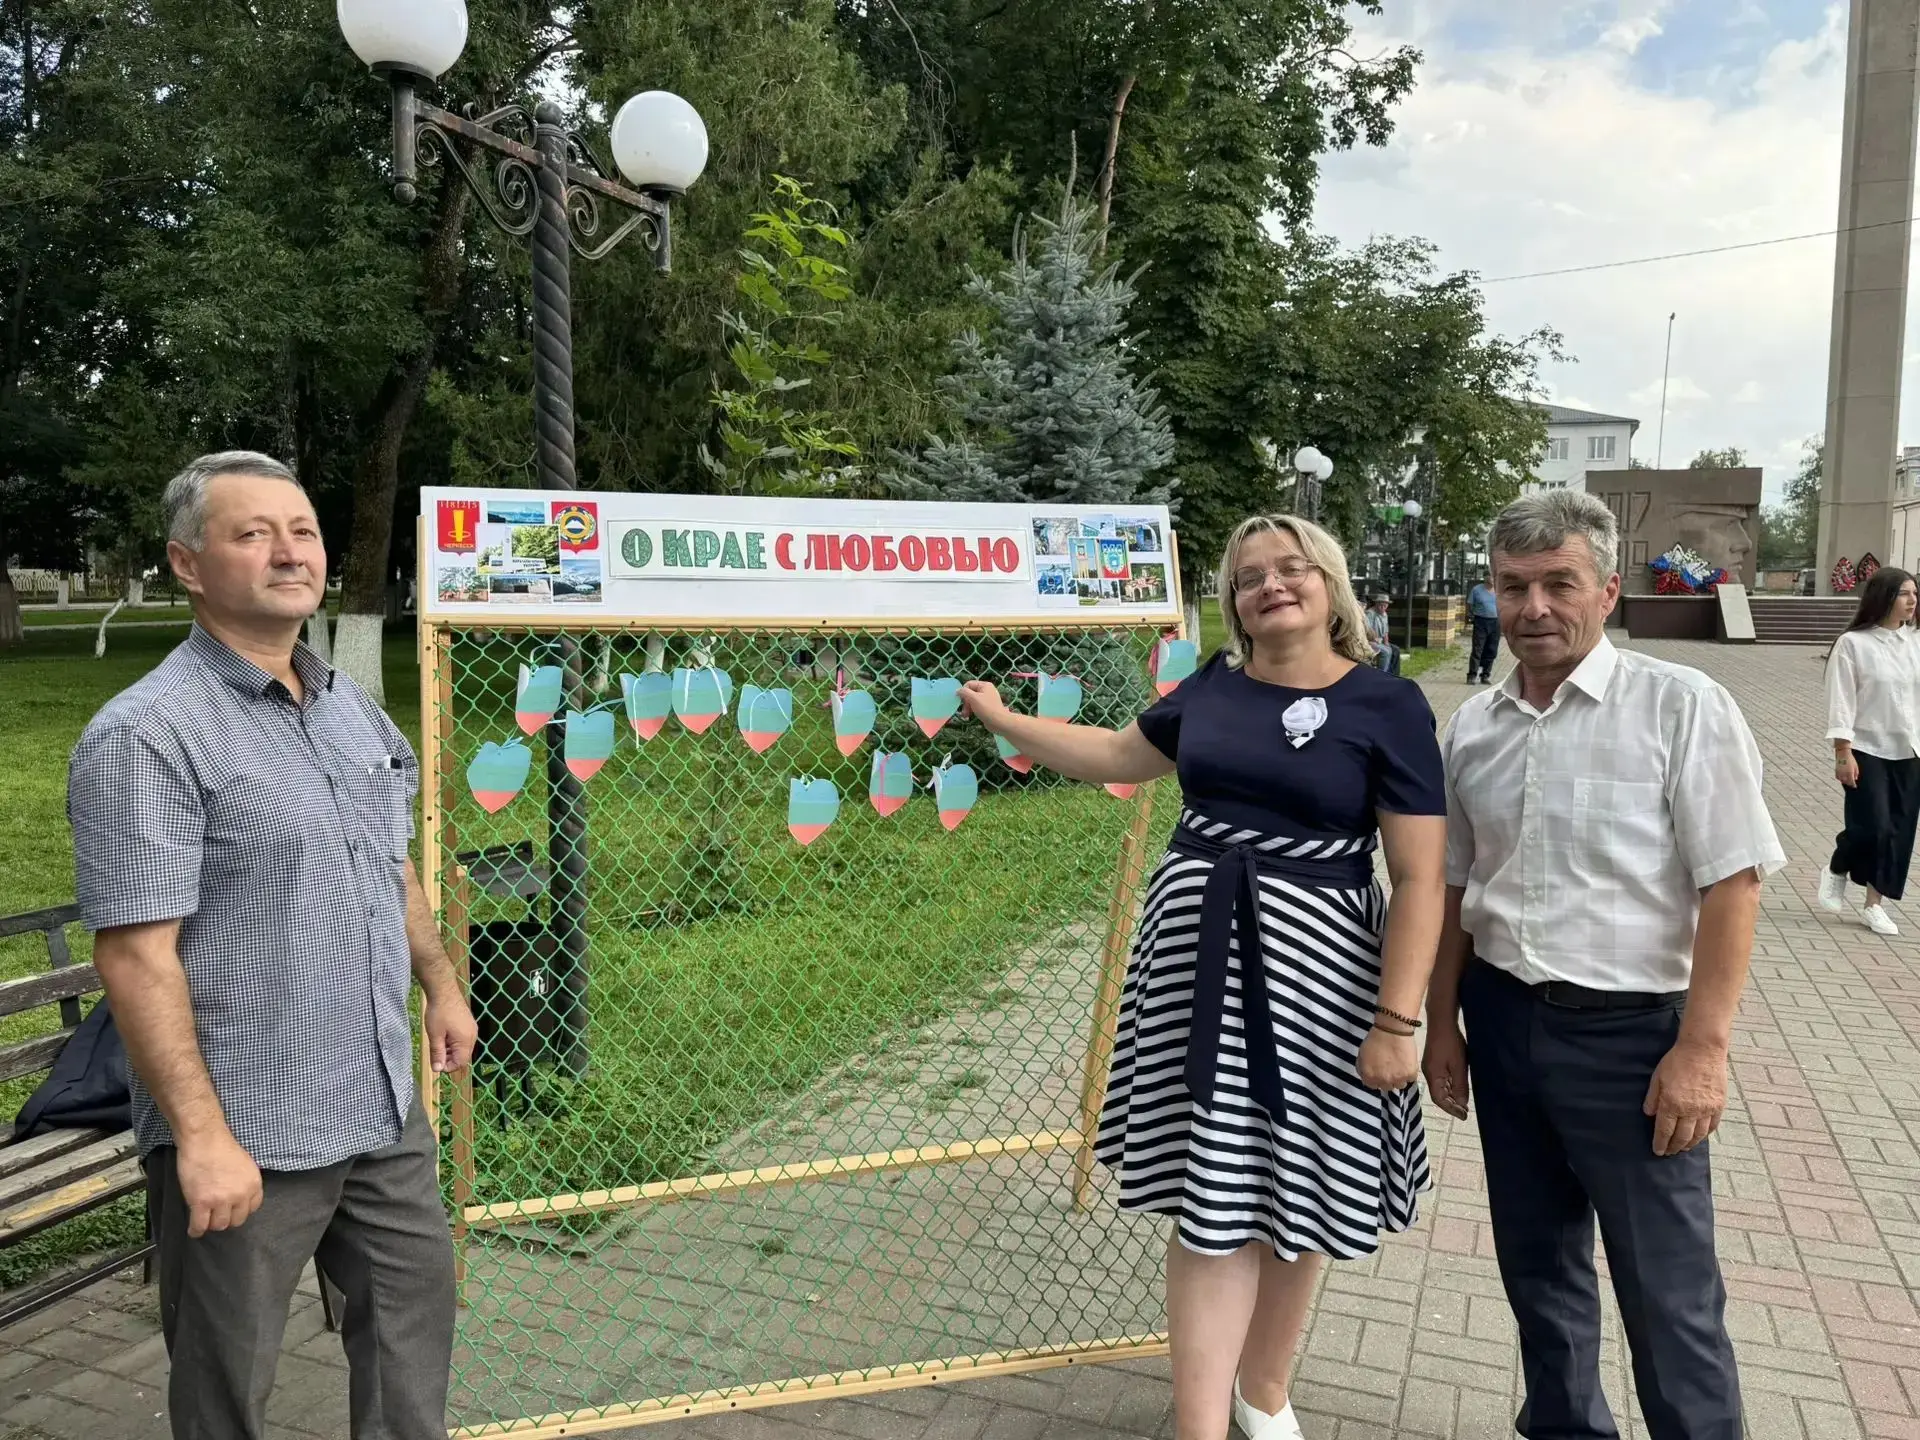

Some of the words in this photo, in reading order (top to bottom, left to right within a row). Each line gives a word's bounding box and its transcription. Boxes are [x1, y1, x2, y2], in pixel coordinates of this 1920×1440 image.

[621, 528, 653, 569] О
[661, 529, 768, 570] КРАЕ
[774, 532, 797, 571] С
[804, 533, 1020, 574] ЛЮБОВЬЮ
